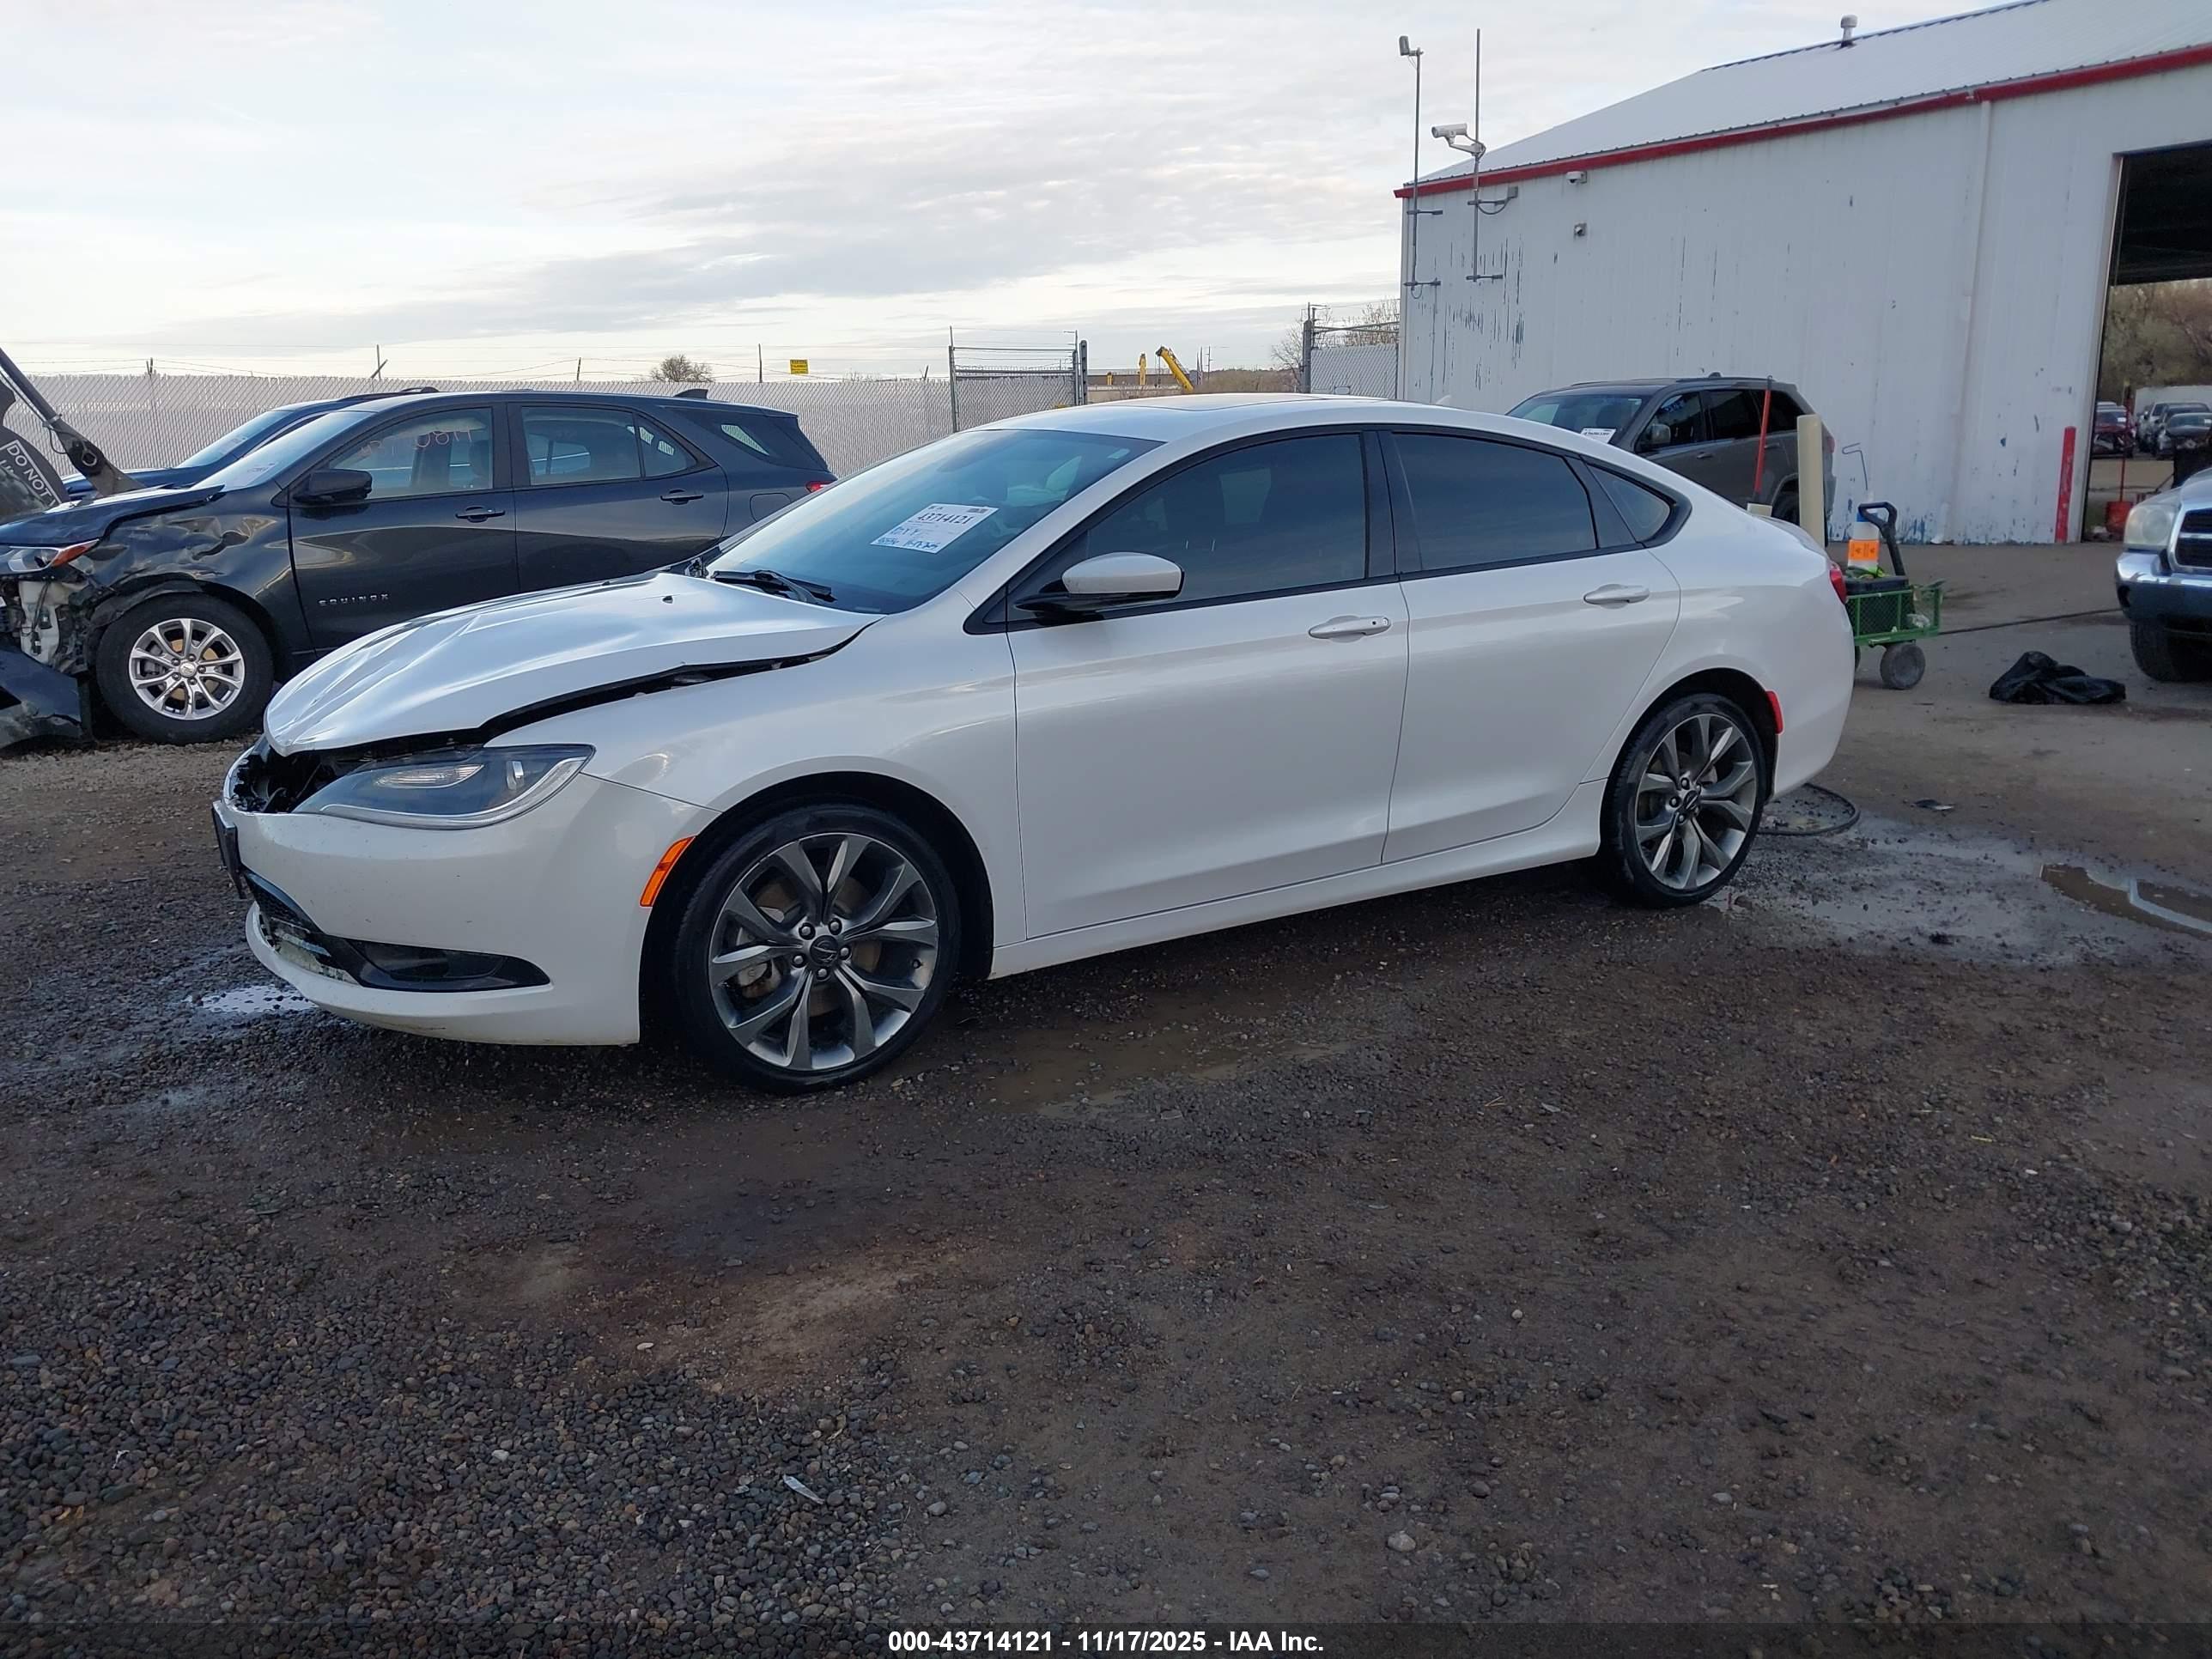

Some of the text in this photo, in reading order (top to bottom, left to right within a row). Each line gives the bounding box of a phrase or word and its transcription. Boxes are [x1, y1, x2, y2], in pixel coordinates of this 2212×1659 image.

[7, 445, 27, 466] DO
[23, 468, 52, 496] NOT
[917, 513, 975, 525] 43714121
[319, 593, 388, 606] EQUINOX
